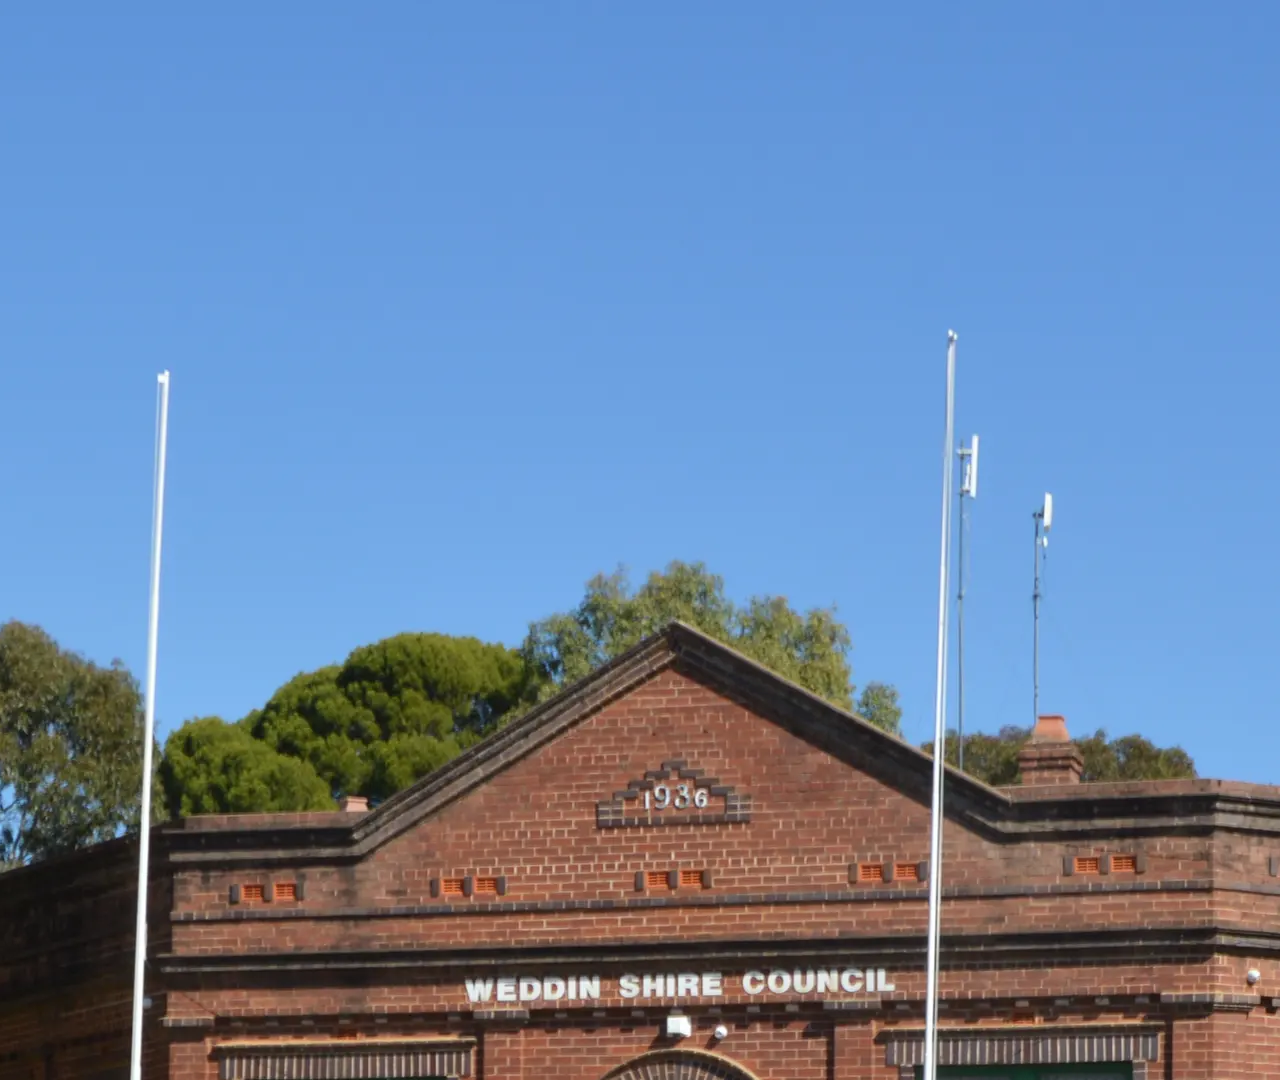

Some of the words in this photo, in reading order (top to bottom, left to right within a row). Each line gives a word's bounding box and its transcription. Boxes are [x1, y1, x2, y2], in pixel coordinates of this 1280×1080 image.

[644, 783, 708, 810] 1936
[464, 975, 601, 1003] WEDDIN
[619, 972, 723, 999] SHIRE
[742, 967, 896, 995] COUNCIL
